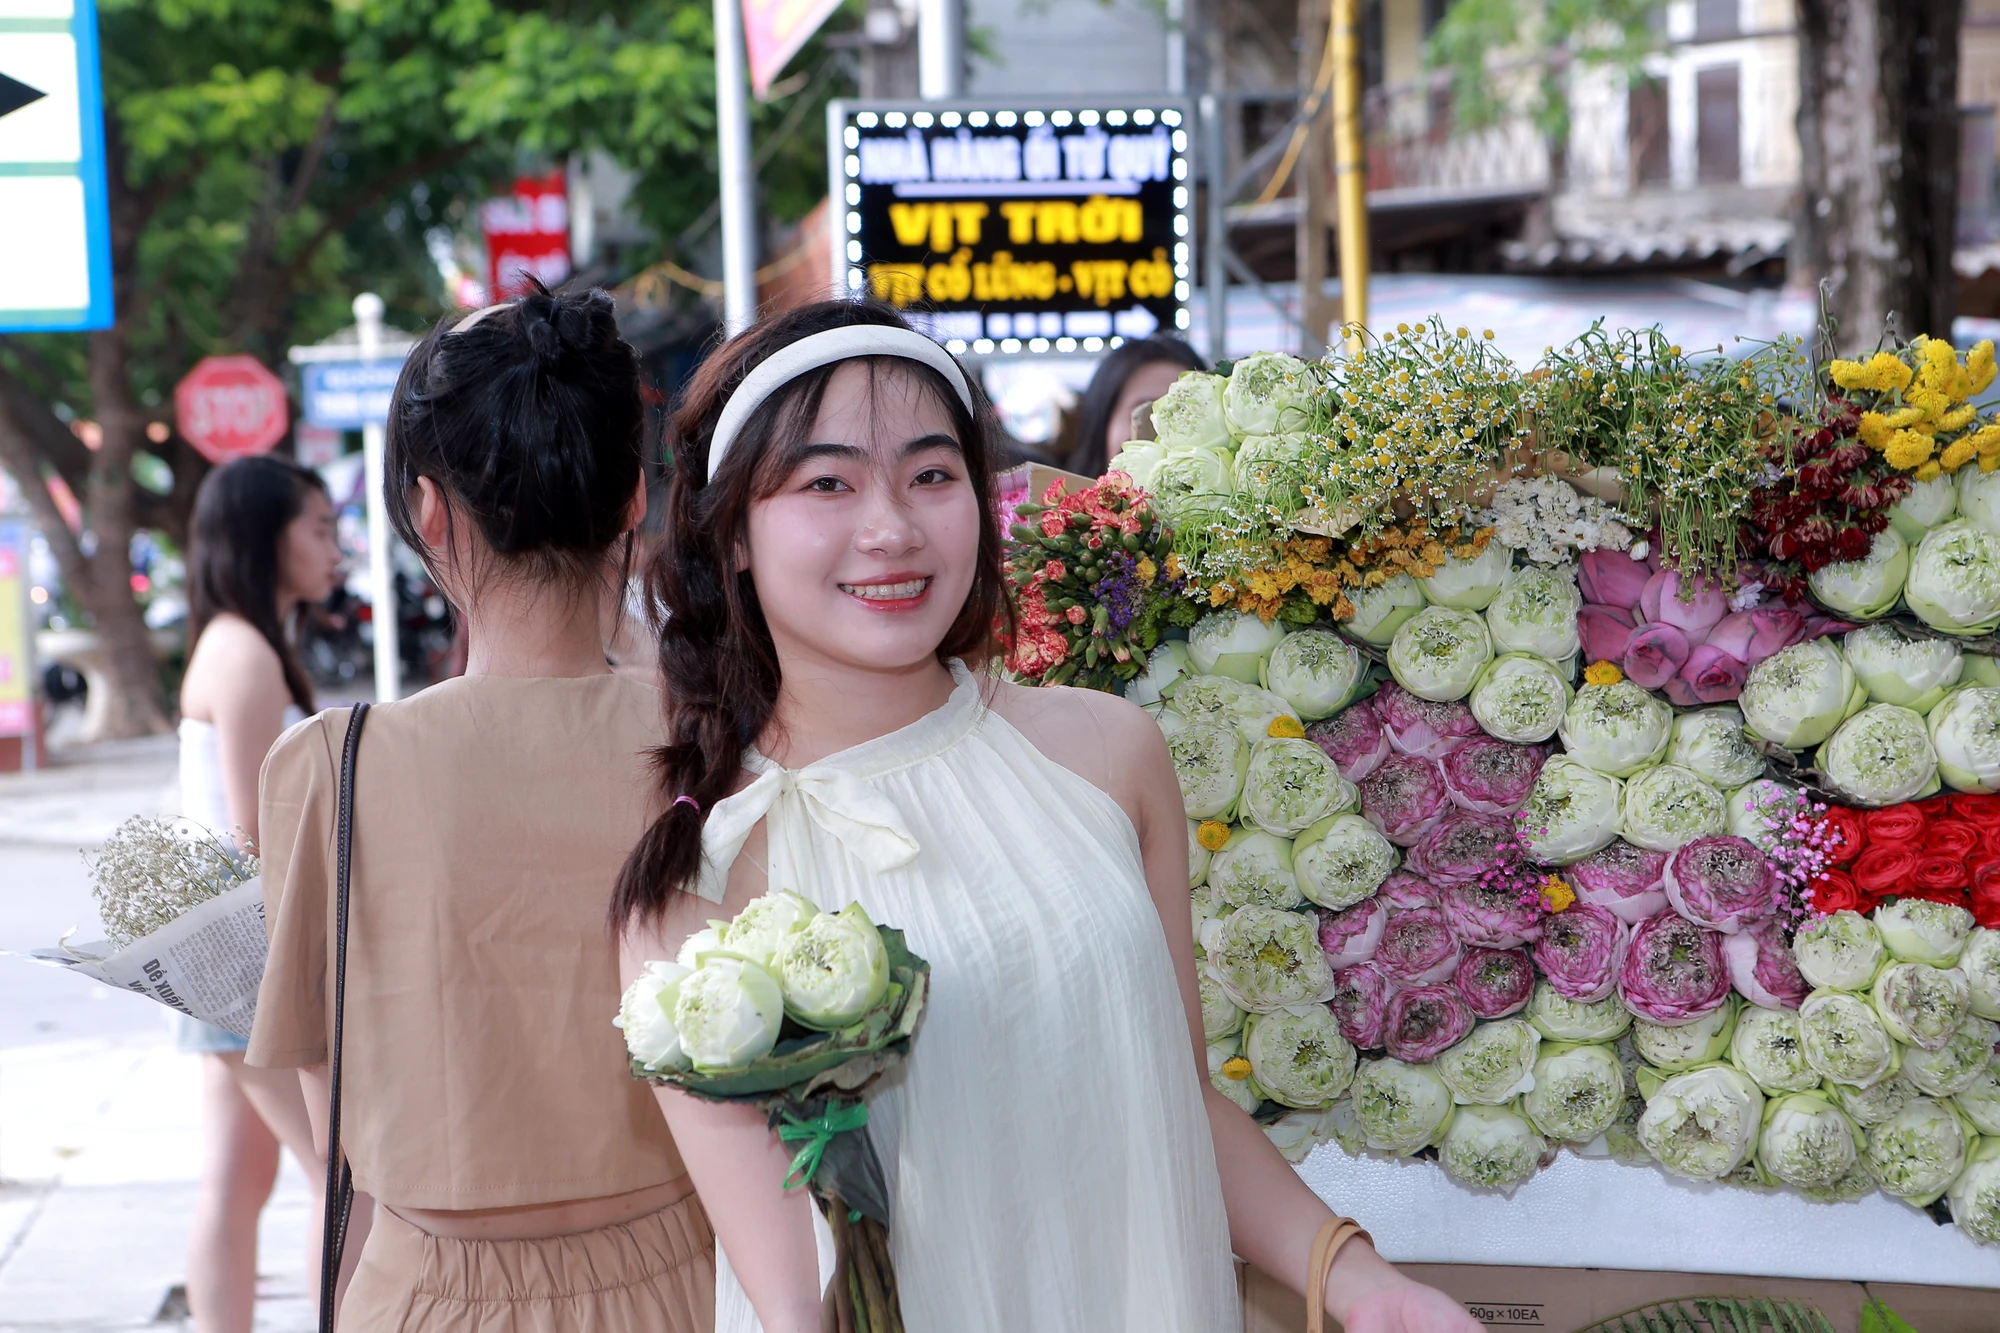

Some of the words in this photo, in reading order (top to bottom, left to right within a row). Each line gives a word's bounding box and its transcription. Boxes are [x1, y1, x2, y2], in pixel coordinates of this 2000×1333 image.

[889, 202, 989, 252] VỊT
[1000, 194, 1143, 243] TRỜI
[1071, 260, 1129, 307] VỊT
[189, 384, 277, 437] STOP
